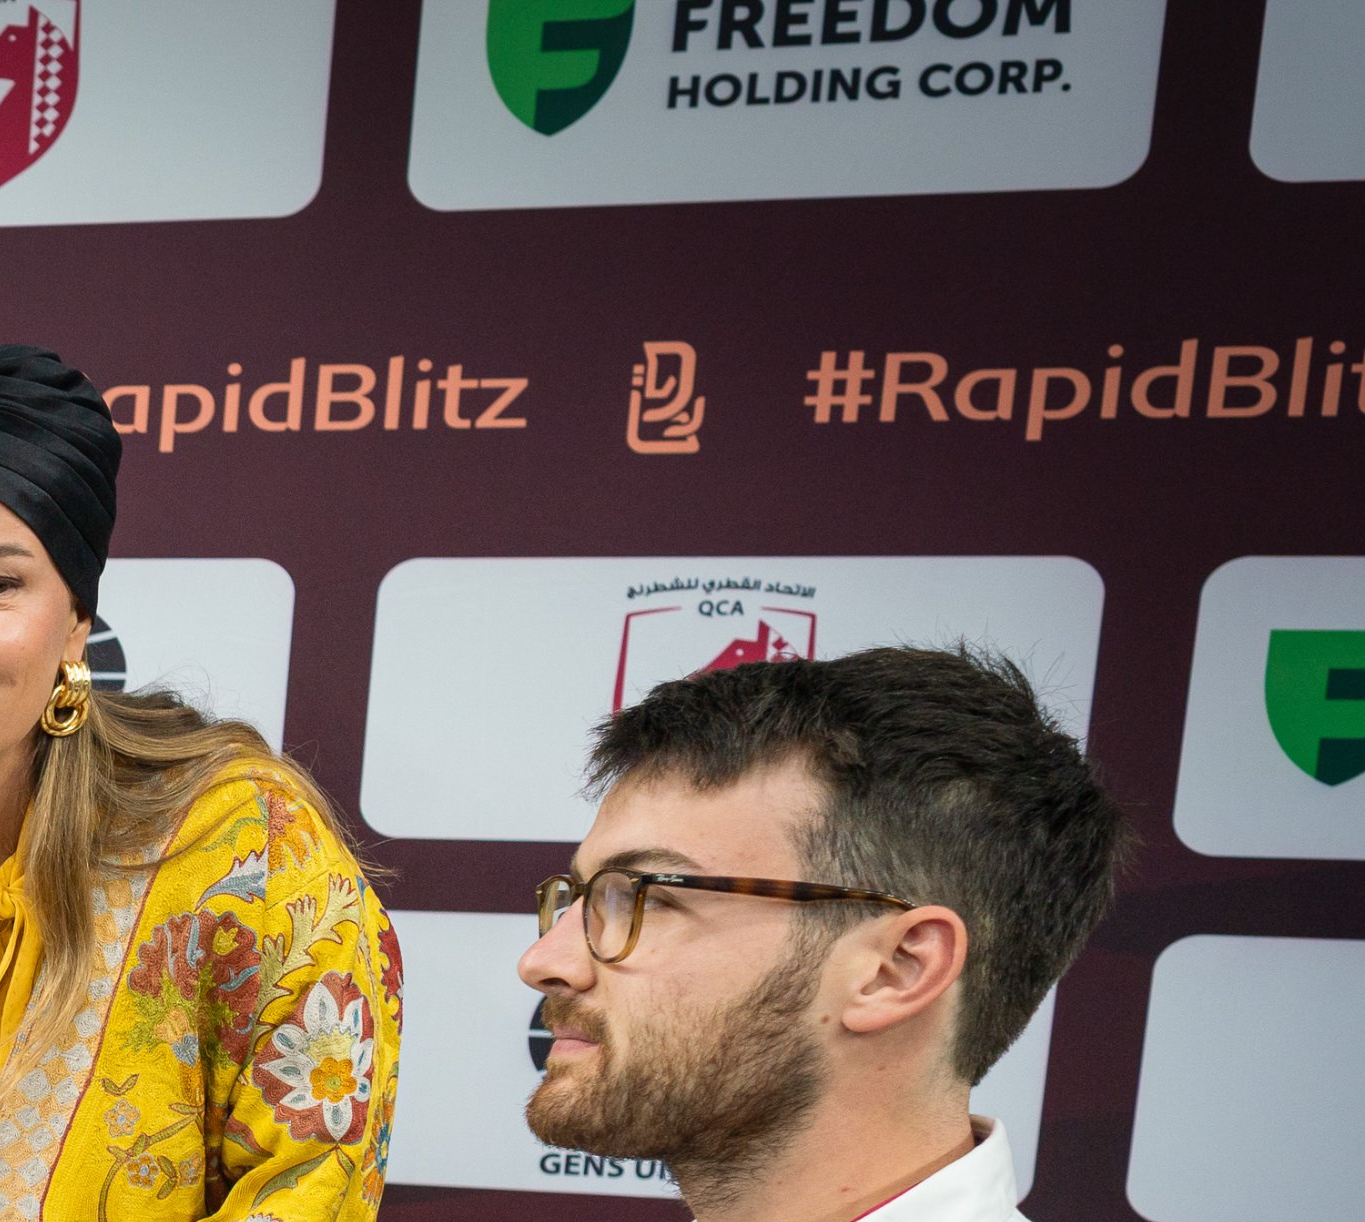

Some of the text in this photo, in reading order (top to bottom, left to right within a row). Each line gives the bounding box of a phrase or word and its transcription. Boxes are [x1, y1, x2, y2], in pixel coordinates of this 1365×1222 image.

[671, 0, 1071, 52] FREEDOM
[667, 58, 1072, 109] HOLDING CORP.
[102, 355, 529, 453] apidBlitz
[698, 600, 745, 618] QCA
[539, 1152, 625, 1178] GENS
